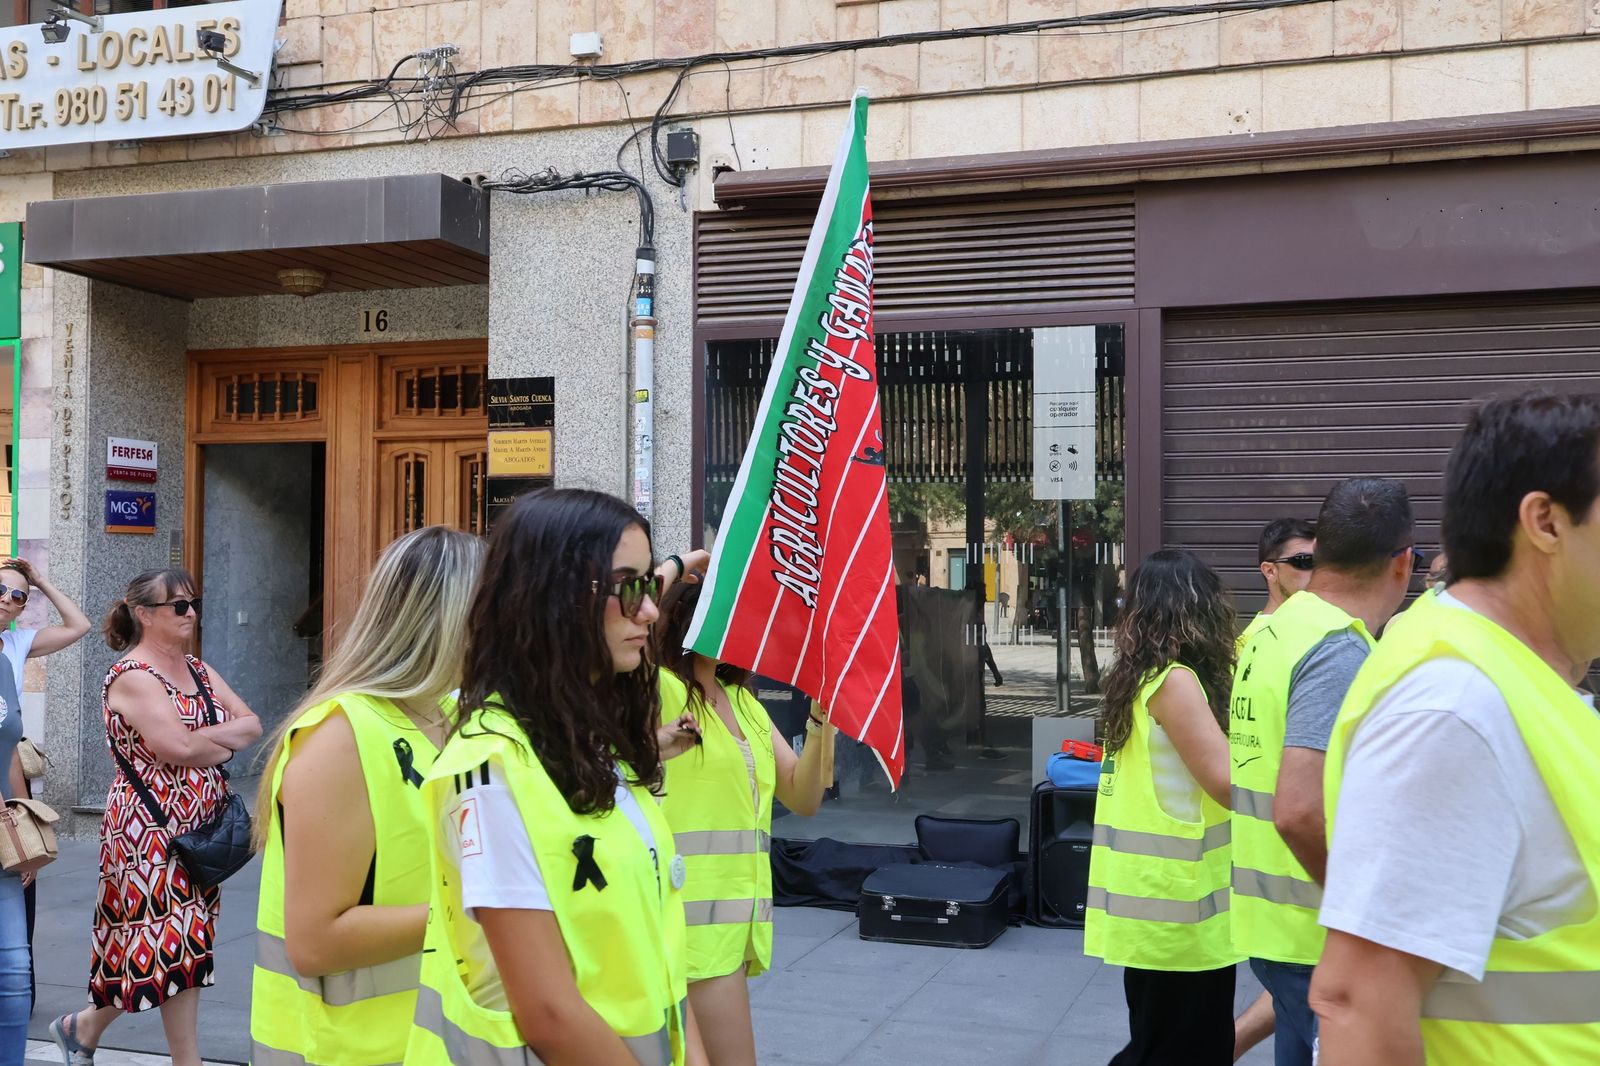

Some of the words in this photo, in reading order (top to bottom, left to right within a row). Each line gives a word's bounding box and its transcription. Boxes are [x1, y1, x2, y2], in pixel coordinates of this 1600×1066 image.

[54, 85, 107, 126] 980
[116, 80, 148, 121] 51
[158, 76, 195, 117] 43
[203, 73, 236, 113] 01
[364, 310, 388, 332] 16
[112, 445, 153, 461] FERFESA
[769, 369, 840, 609] AGRICULTORES
[110, 501, 138, 514] MGS
